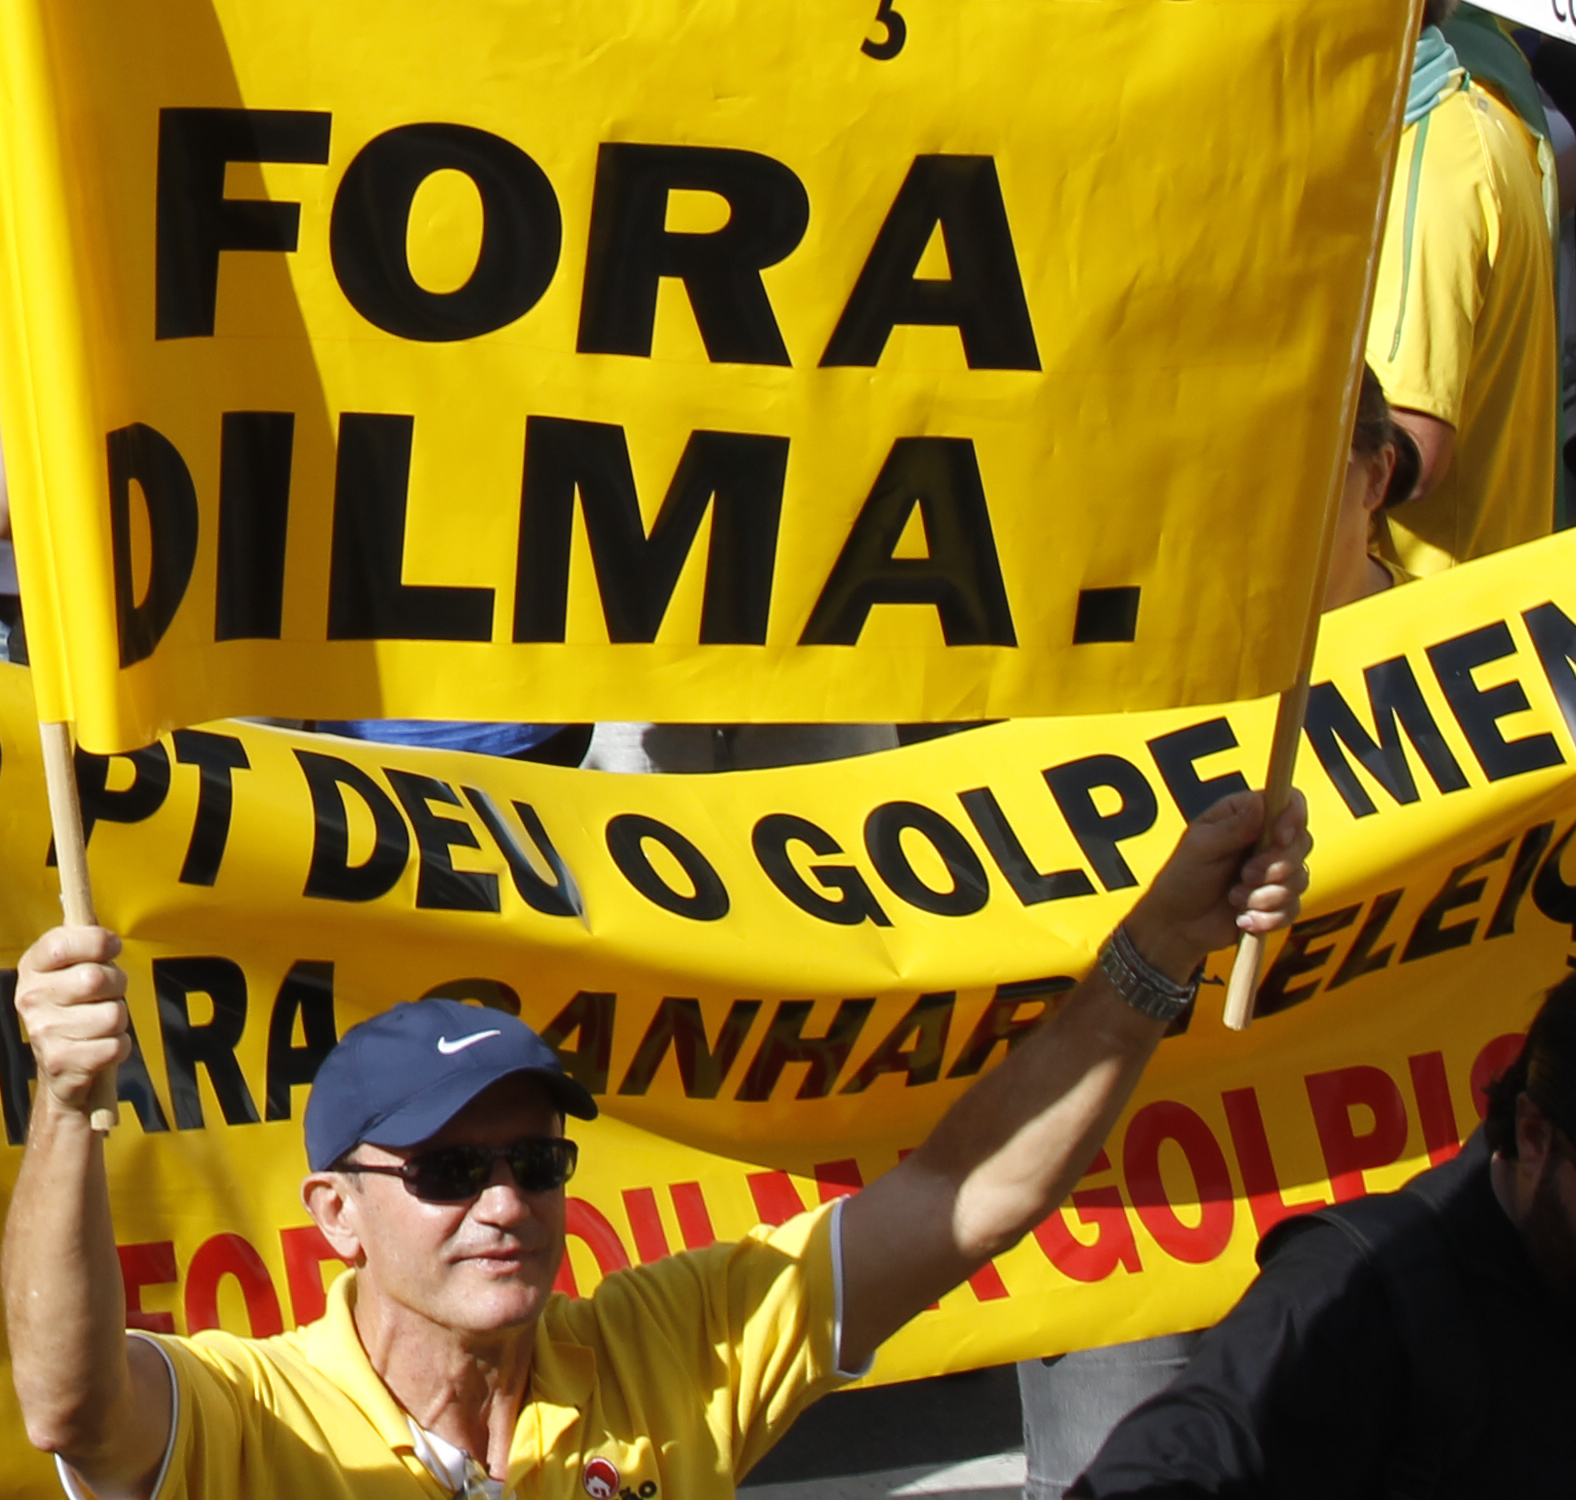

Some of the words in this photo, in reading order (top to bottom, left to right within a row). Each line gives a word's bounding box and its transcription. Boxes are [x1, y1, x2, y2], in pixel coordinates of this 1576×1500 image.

[156, 106, 1043, 374] FORA
[105, 409, 1141, 670] DILMA.
[46, 728, 252, 887] PT
[291, 747, 594, 922] DEU
[605, 812, 730, 923] O
[750, 716, 1256, 928] GOLPE
